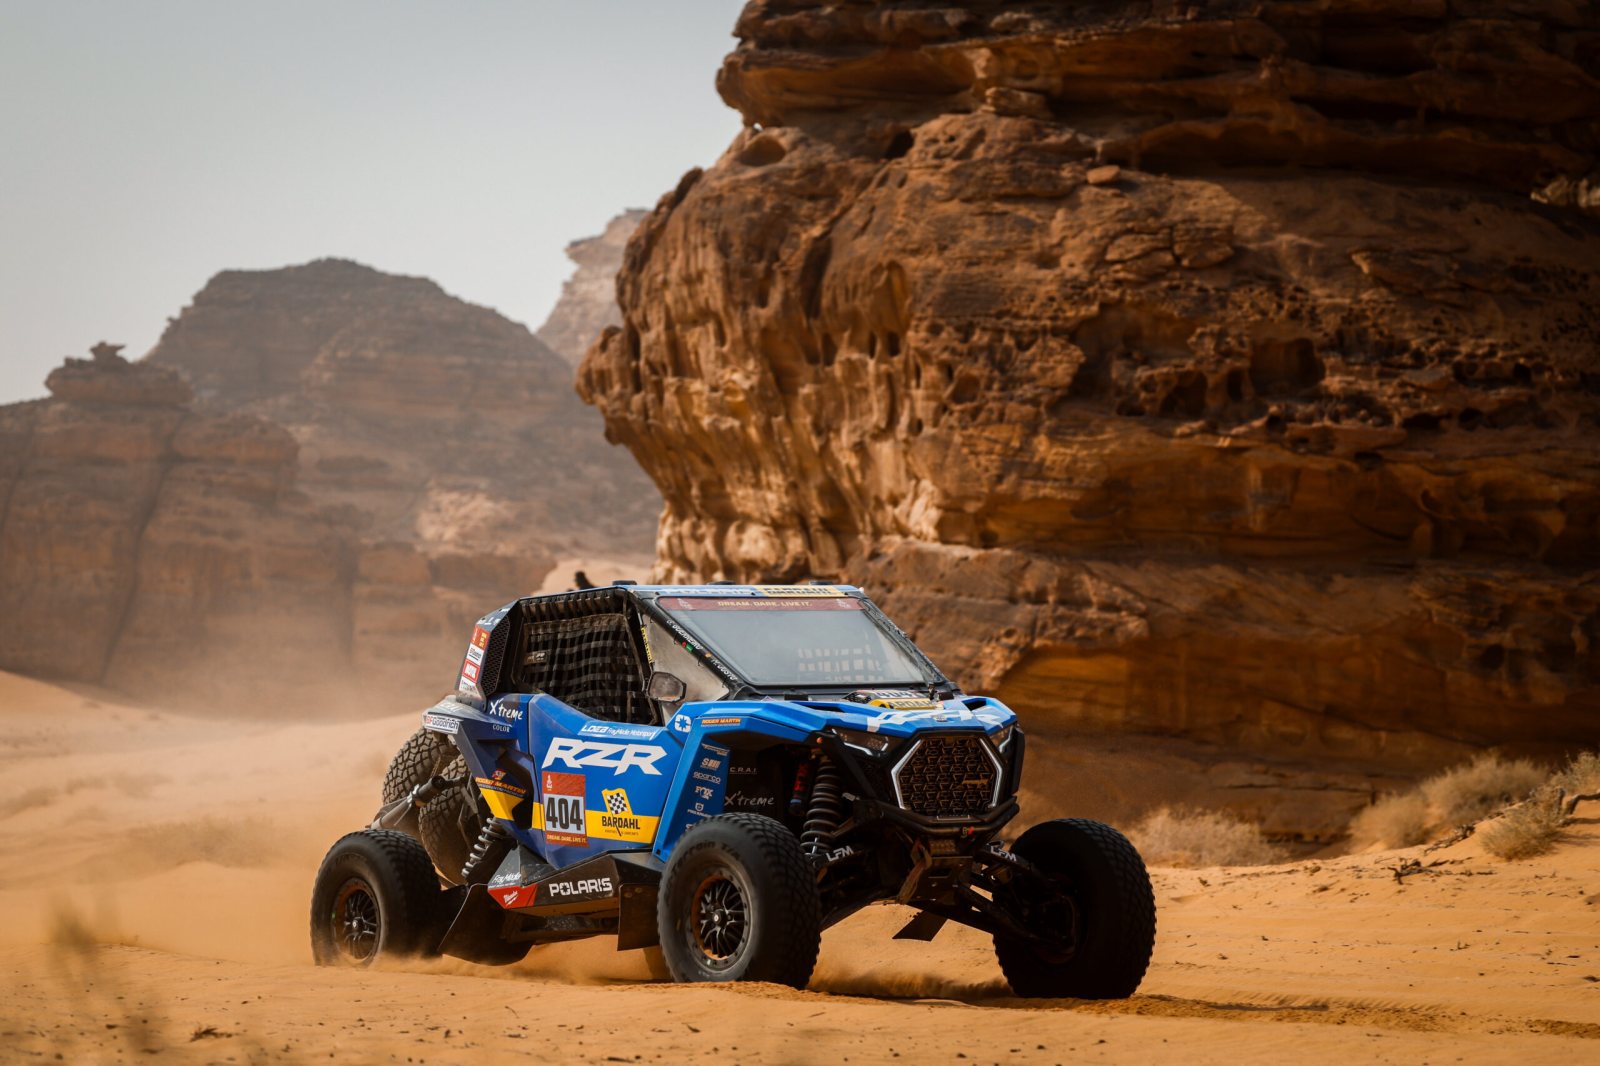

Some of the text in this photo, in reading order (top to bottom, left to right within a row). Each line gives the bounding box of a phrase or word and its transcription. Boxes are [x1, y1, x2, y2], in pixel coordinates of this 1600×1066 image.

[492, 724, 511, 733] COLOR
[541, 736, 668, 776] RZR
[545, 797, 584, 831] 404
[601, 815, 641, 830] BARDAHL
[548, 878, 613, 897] POLARIS
